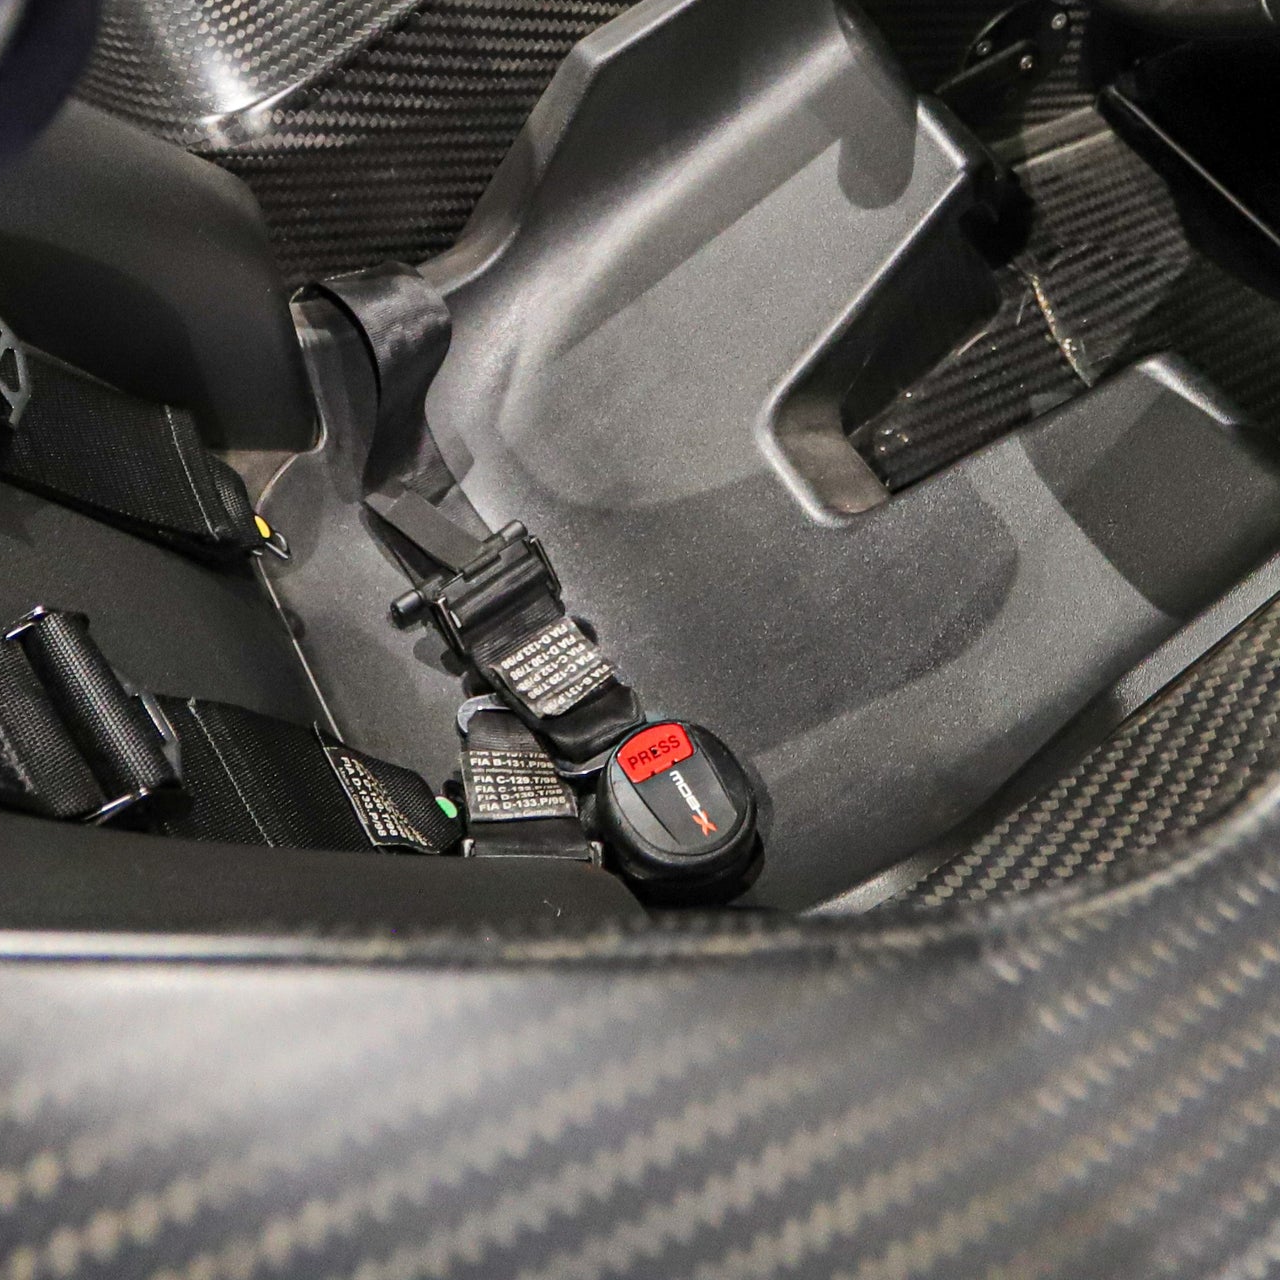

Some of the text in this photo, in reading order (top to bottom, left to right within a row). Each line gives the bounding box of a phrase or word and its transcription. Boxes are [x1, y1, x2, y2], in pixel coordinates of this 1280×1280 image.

[627, 735, 680, 770] PRESS
[470, 758, 490, 767] FIA
[473, 775, 493, 784] FIA
[479, 802, 500, 812] FIA
